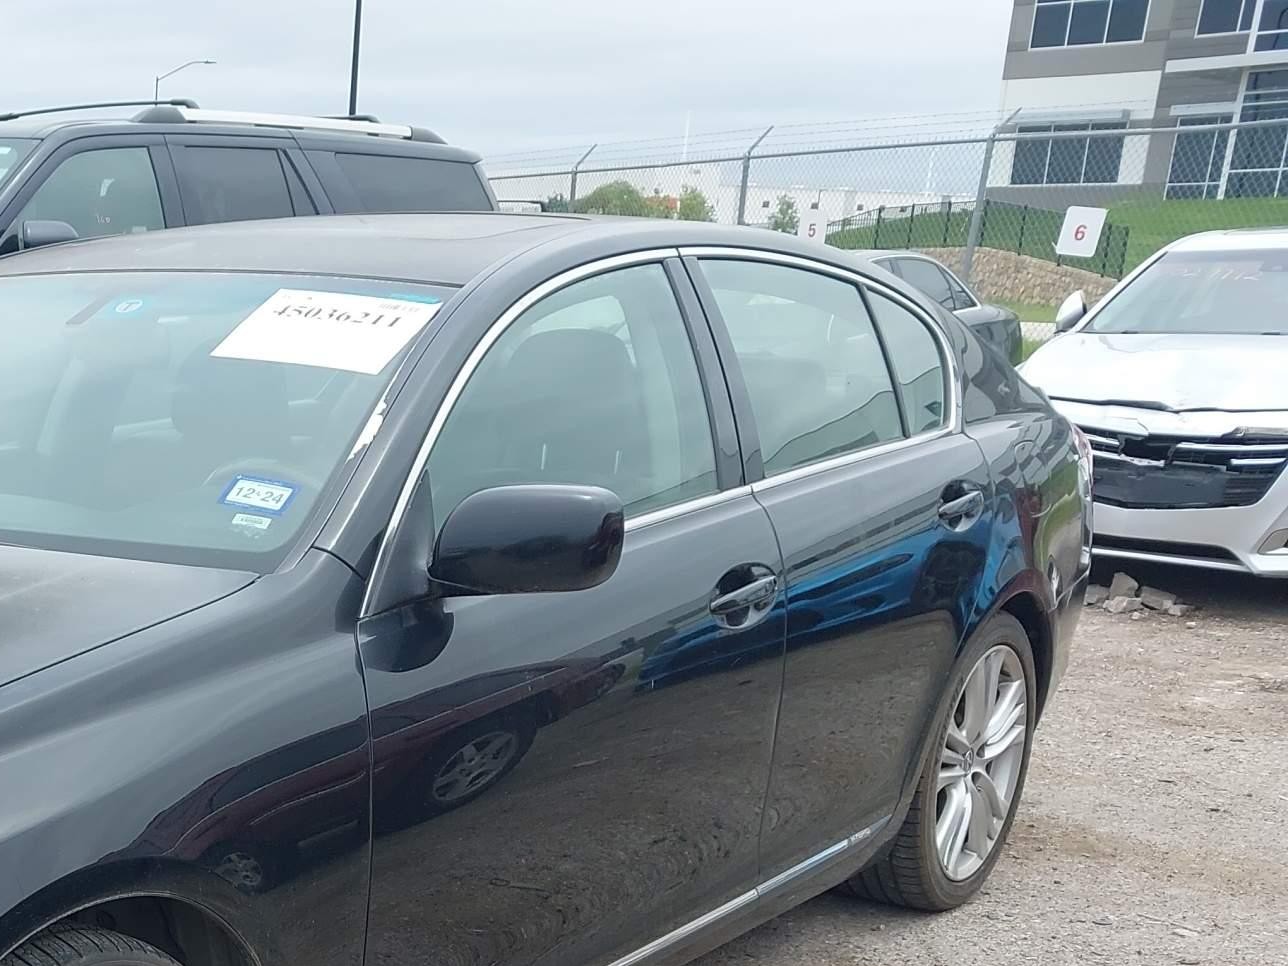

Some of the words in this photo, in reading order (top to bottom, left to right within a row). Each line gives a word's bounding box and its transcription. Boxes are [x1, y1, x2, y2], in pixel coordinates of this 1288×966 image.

[807, 223, 817, 238] 5
[1074, 224, 1088, 241] 6
[272, 304, 403, 328] 45036211
